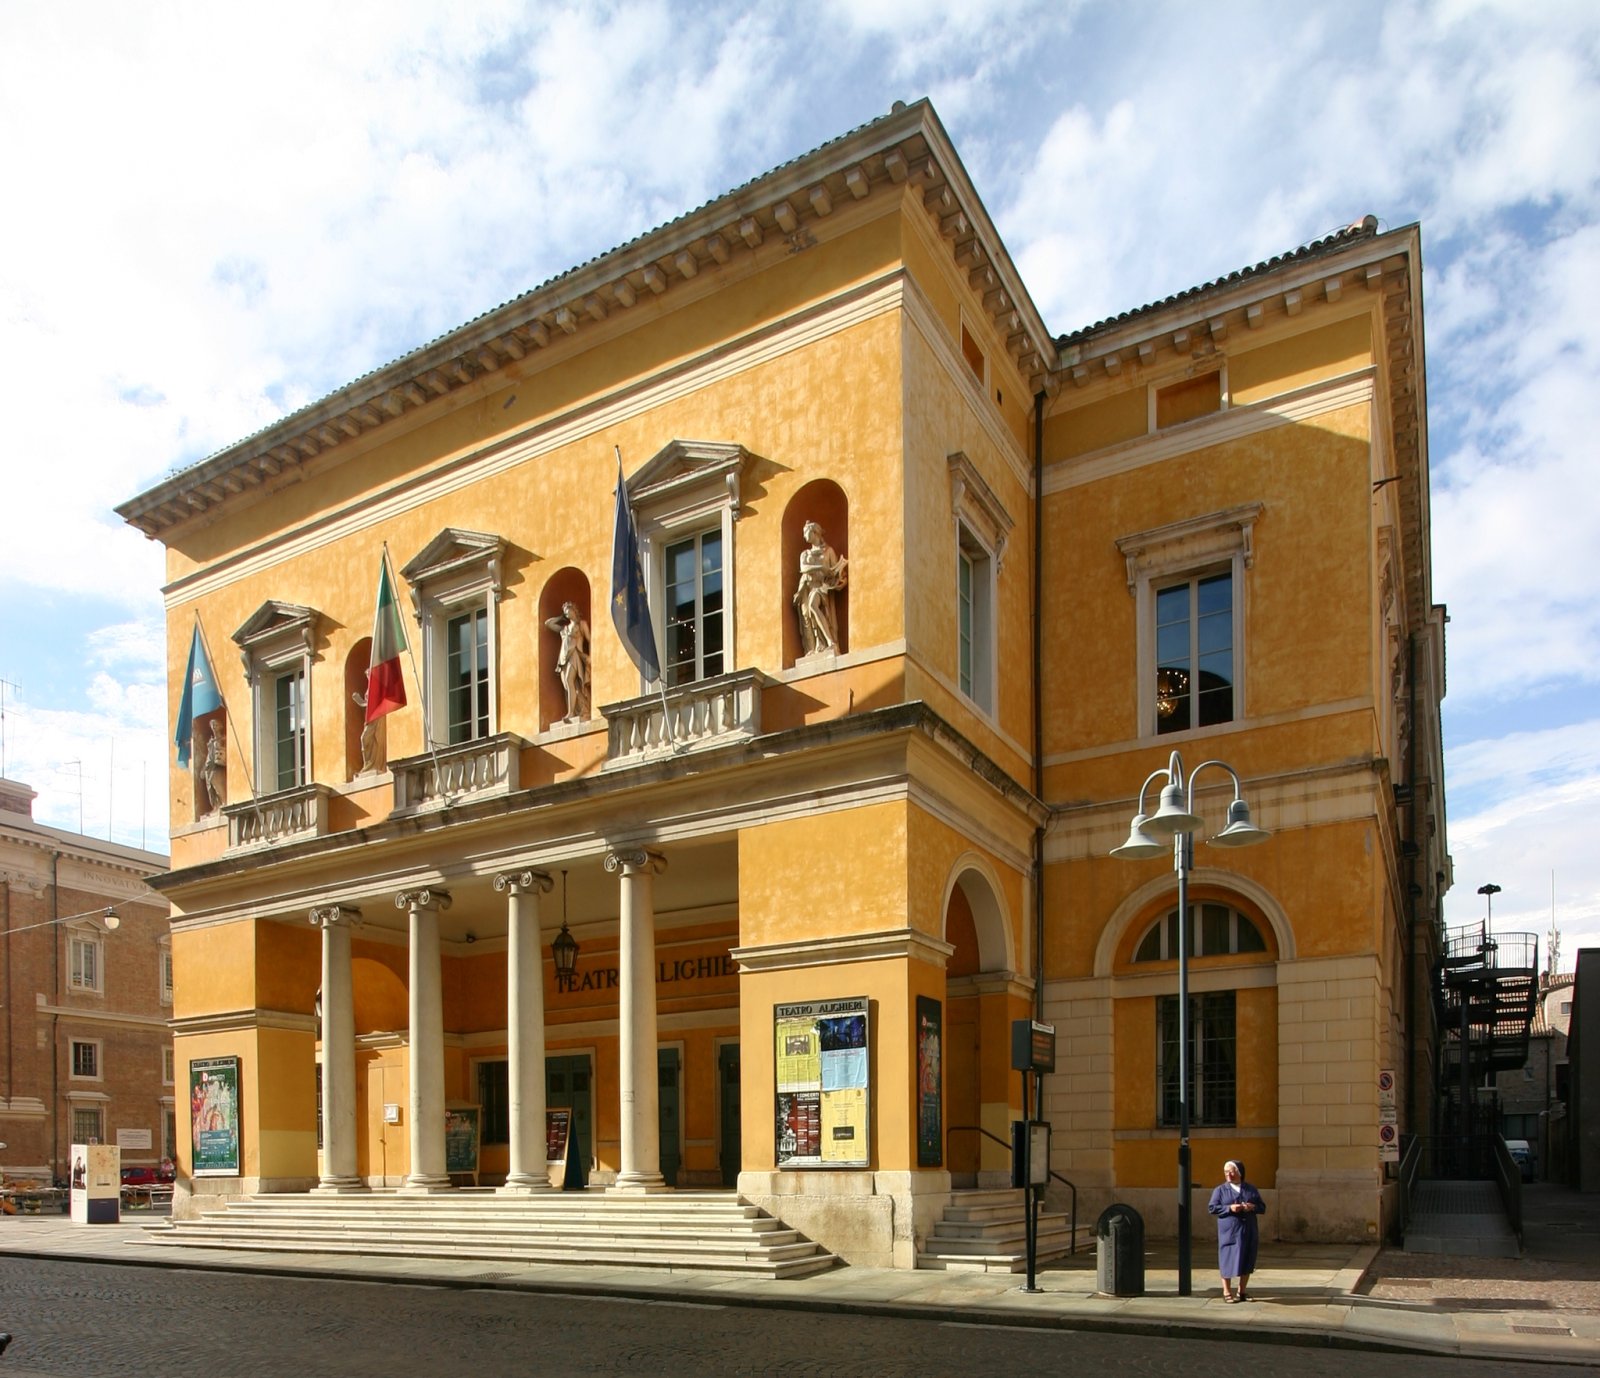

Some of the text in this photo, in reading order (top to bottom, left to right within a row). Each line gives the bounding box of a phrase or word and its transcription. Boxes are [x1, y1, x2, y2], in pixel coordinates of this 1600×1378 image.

[554, 968, 619, 994] TEATR
[779, 1001, 862, 1016] TEATRO ALIGHIERI
